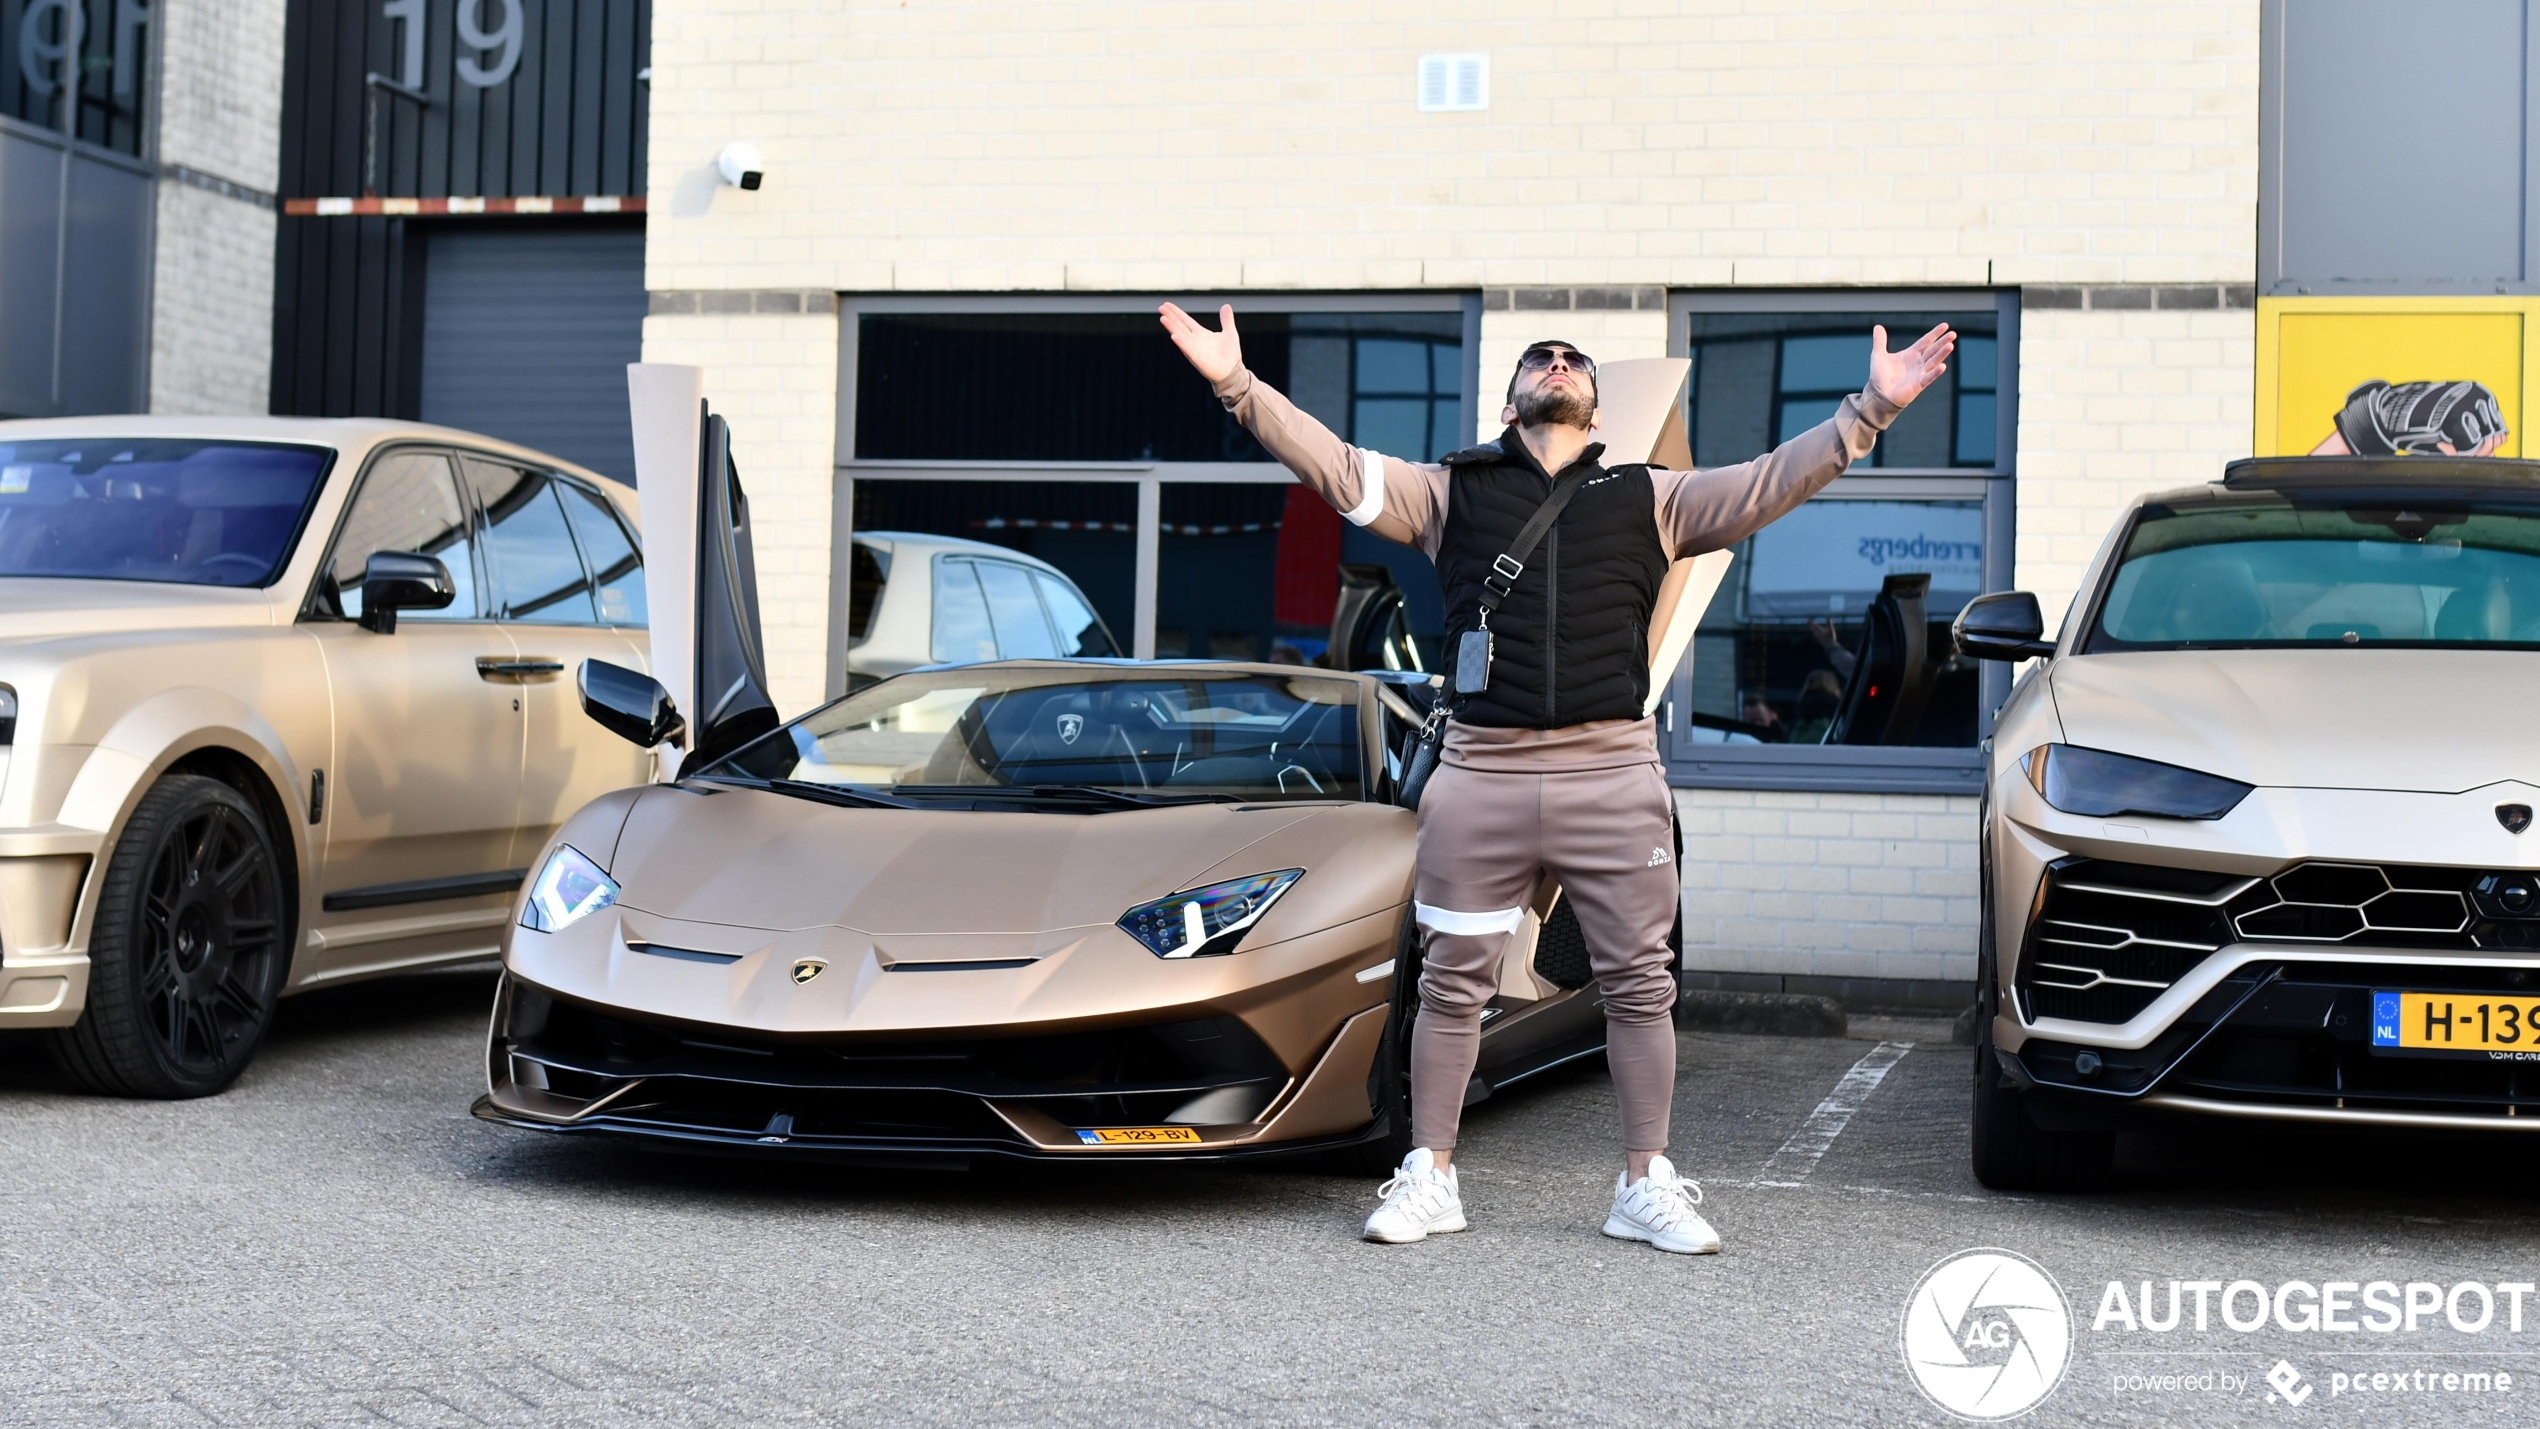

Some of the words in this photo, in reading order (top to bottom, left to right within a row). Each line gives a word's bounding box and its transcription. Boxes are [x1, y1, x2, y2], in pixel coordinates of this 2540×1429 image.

[384, 0, 525, 90] 19
[2377, 1025, 2397, 1039] NL
[2488, 1051, 2513, 1061] VDM
[1081, 1137, 1103, 1145] NL
[1099, 1129, 1190, 1141] L-129-BV
